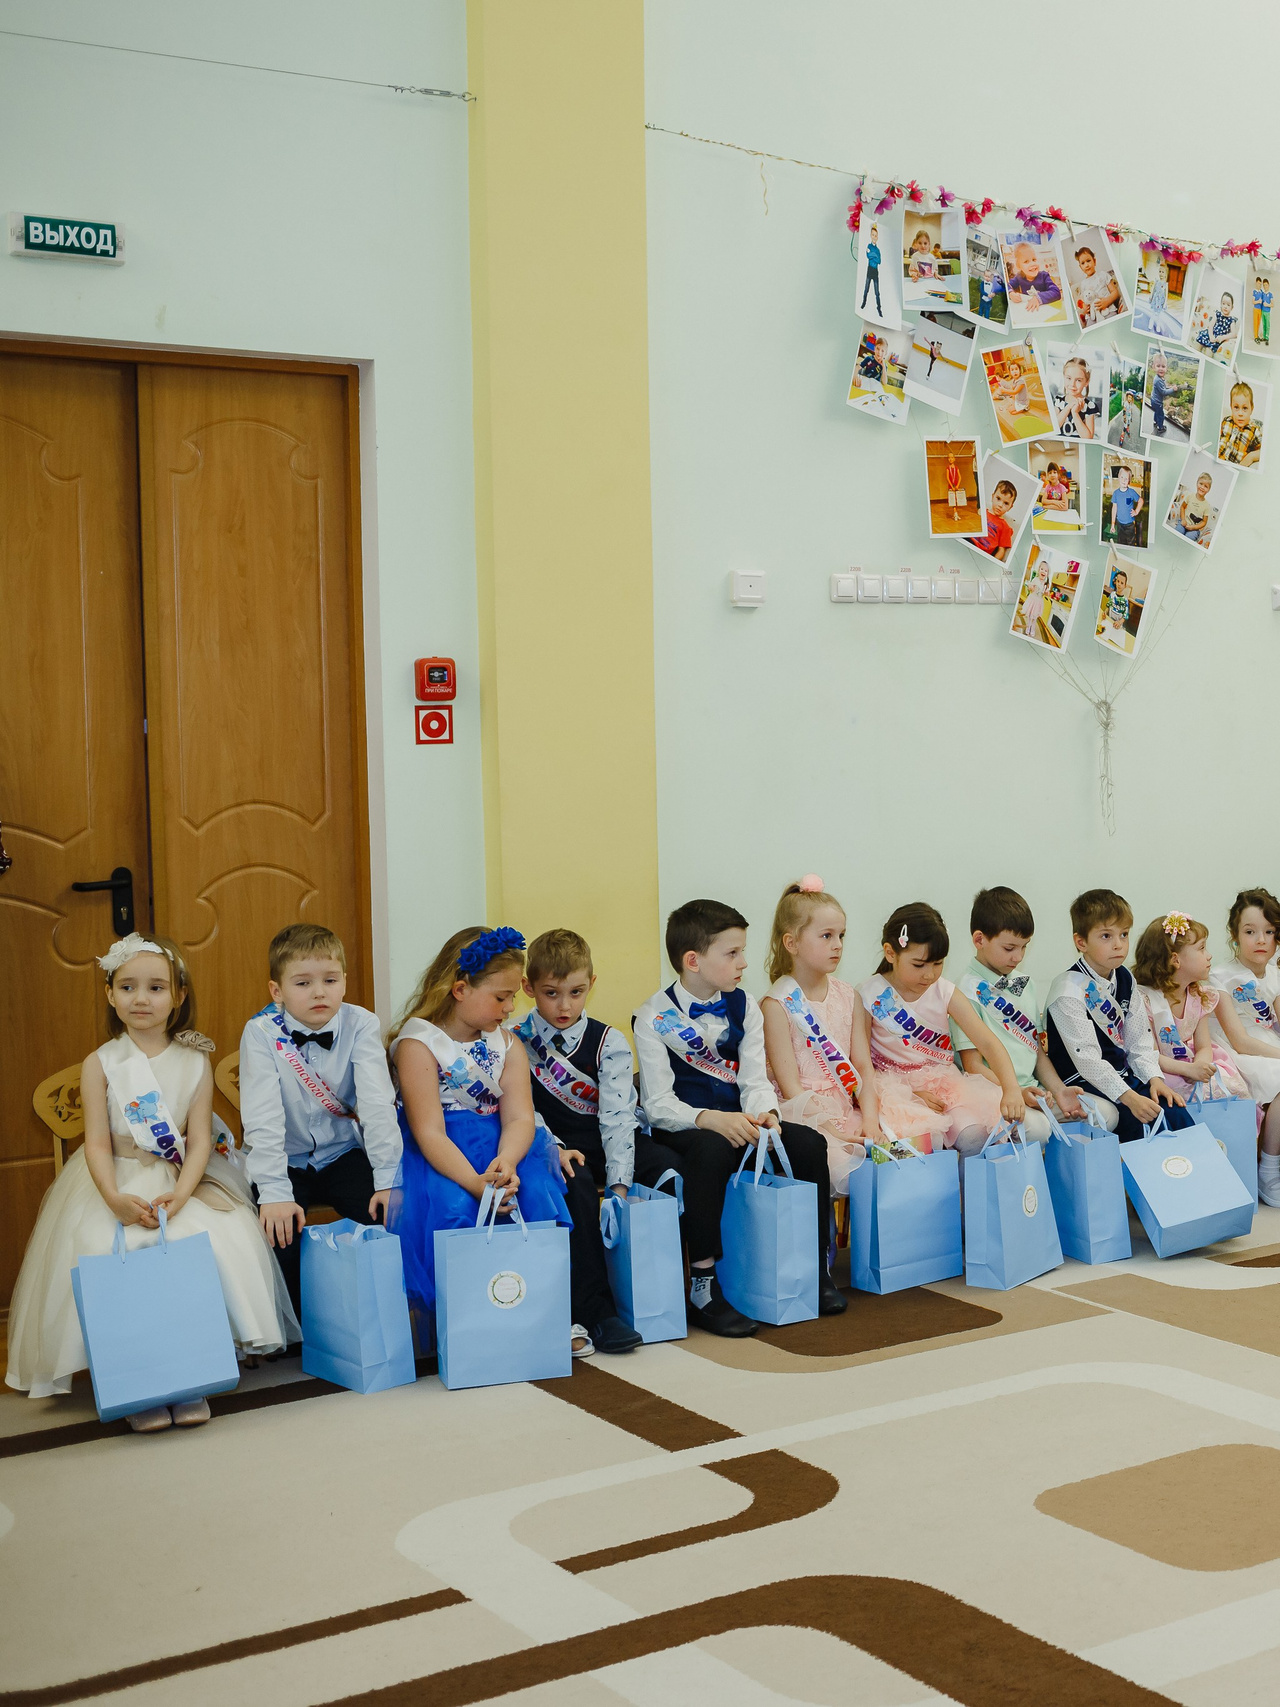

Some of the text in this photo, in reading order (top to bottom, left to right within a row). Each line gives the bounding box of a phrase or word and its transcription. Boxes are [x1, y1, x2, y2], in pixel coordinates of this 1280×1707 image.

[29, 221, 114, 255] ВЫХОД
[912, 1041, 946, 1060] детского
[284, 1050, 325, 1098] детского
[542, 1075, 585, 1111] детского
